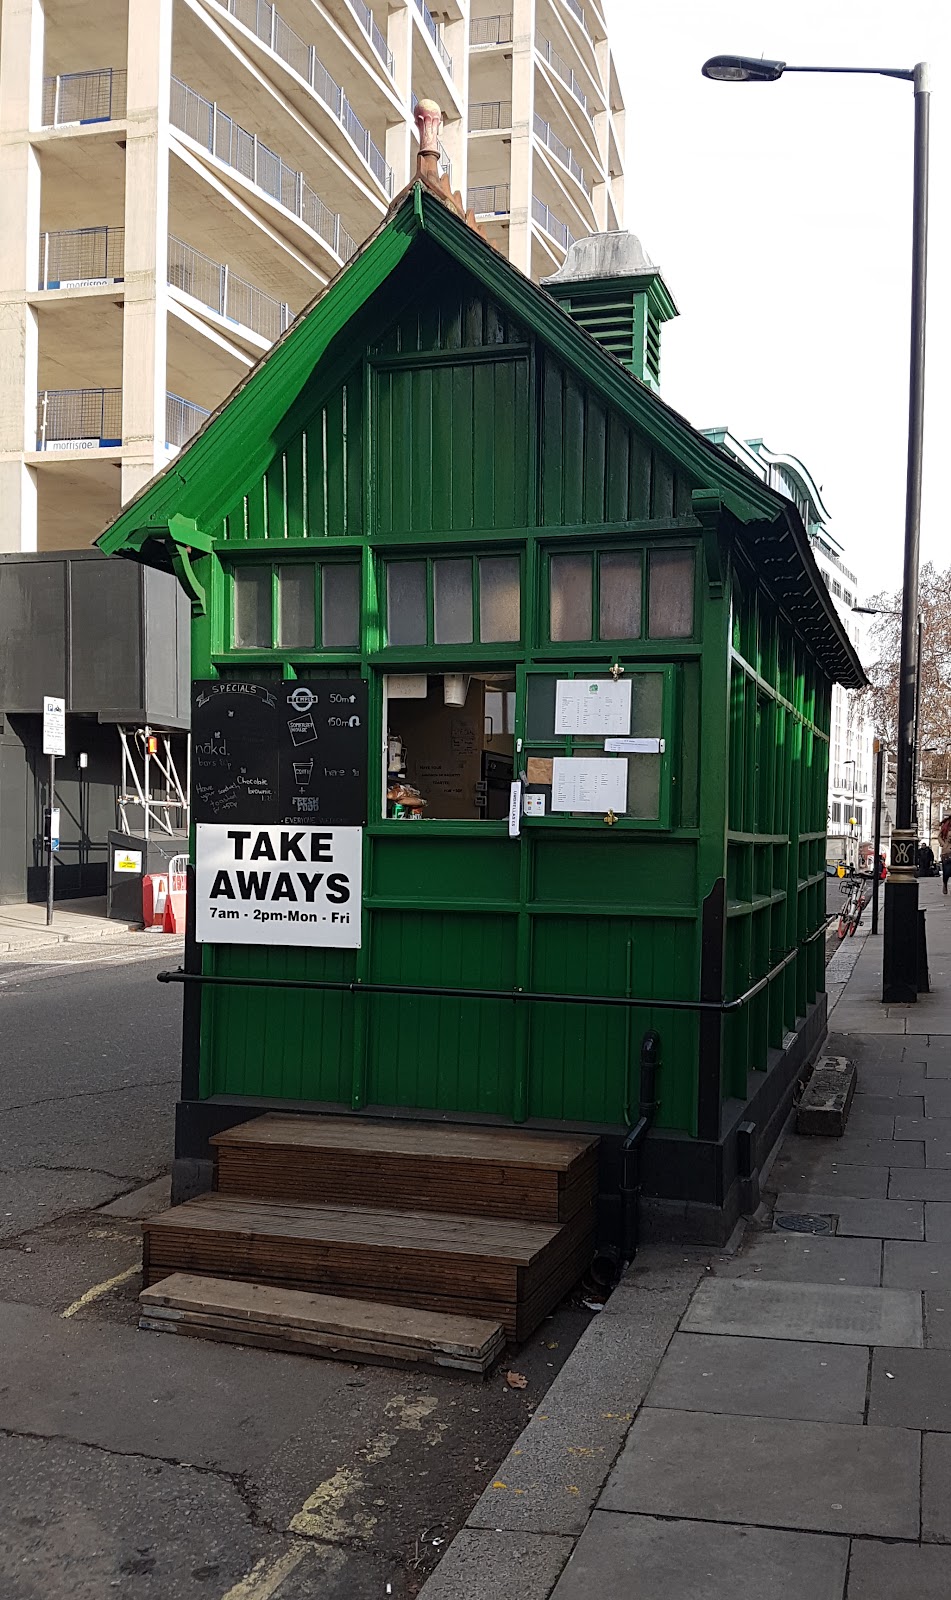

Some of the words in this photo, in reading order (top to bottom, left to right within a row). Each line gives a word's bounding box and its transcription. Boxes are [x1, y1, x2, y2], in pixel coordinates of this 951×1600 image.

[211, 684, 257, 694] SPECIALS
[197, 757, 217, 767] bars
[324, 767, 346, 777] here
[236, 775, 268, 786] Chocolate
[195, 782, 214, 794] Have
[227, 831, 334, 863] TAKE
[209, 870, 351, 904] AWAYS
[209, 907, 240, 919] 7am
[331, 912, 350, 924] Fri
